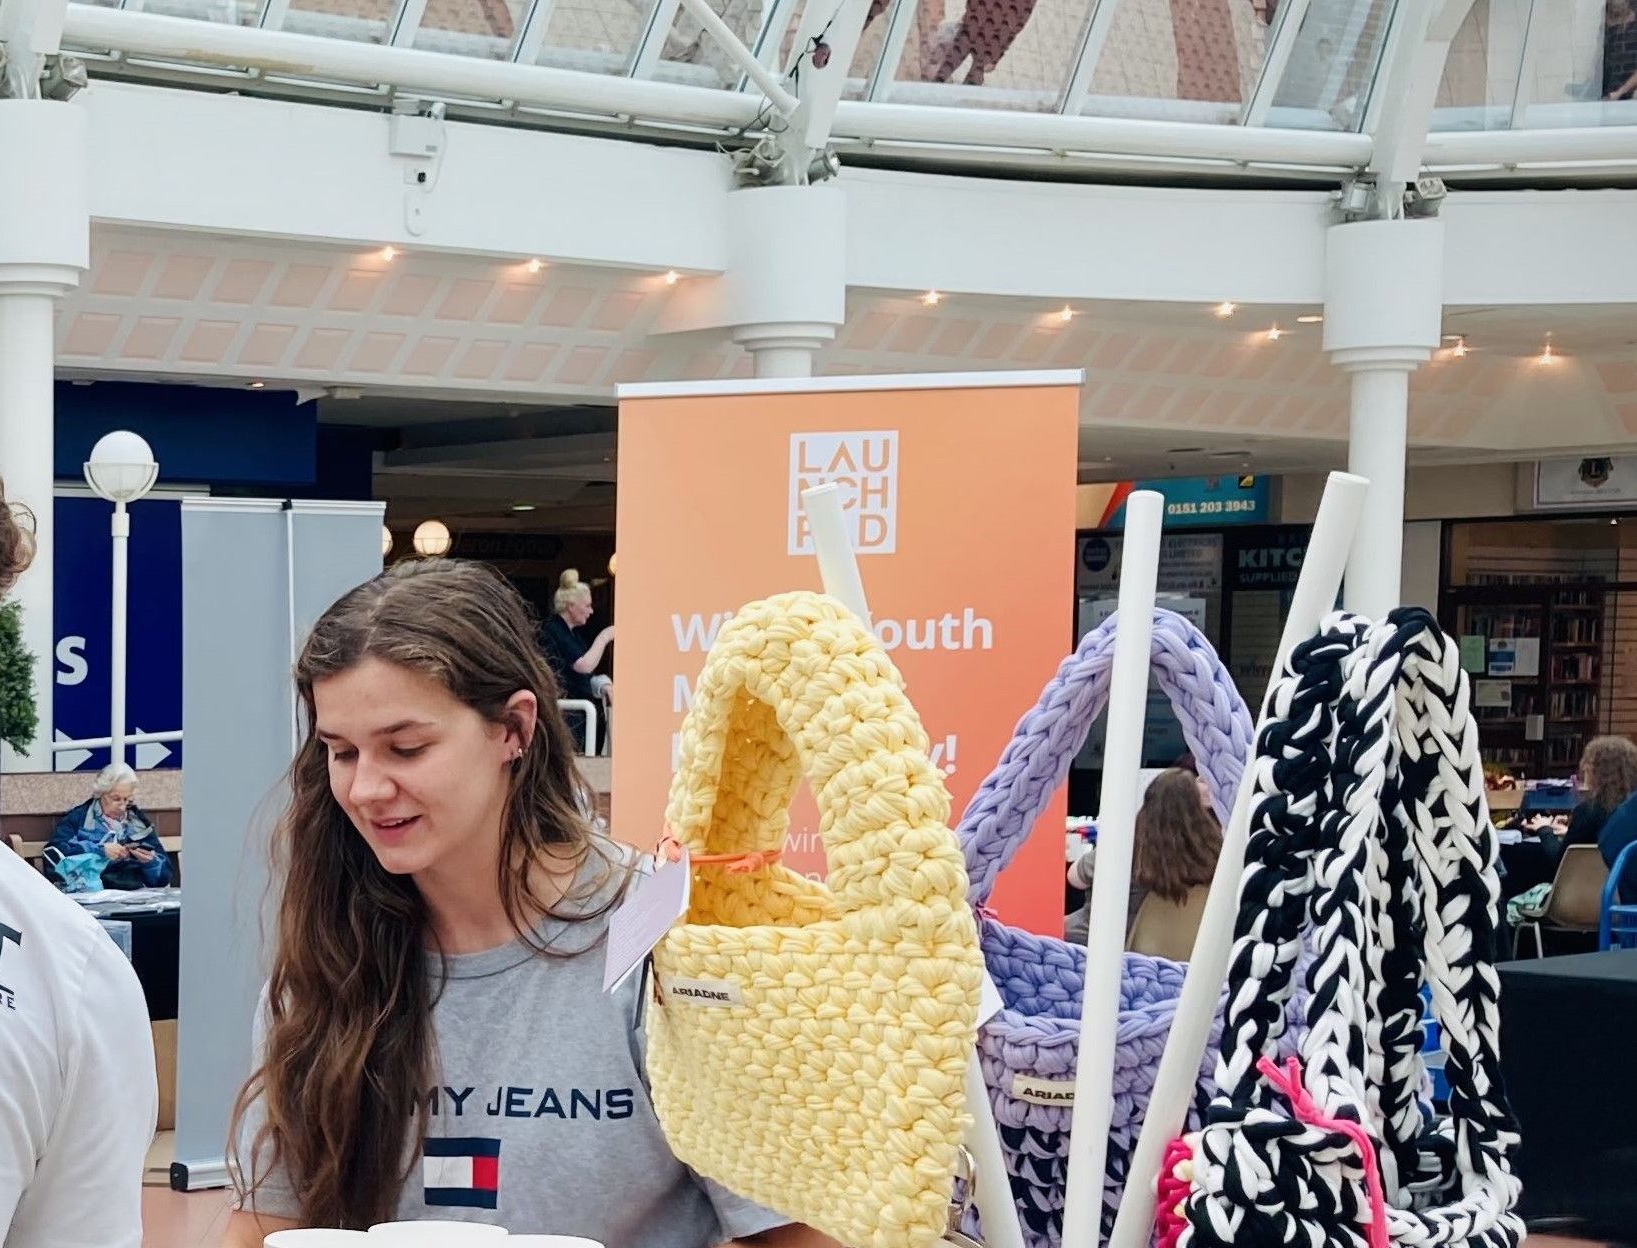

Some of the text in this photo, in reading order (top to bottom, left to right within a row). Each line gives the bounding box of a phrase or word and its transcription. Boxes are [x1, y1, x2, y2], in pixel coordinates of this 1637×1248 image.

[797, 438, 890, 473] LAU
[1200, 501, 1222, 513] 203
[796, 513, 888, 548] PD
[869, 607, 994, 650] outh
[672, 987, 731, 1001] ARIADNE
[486, 1086, 634, 1121] JEANS
